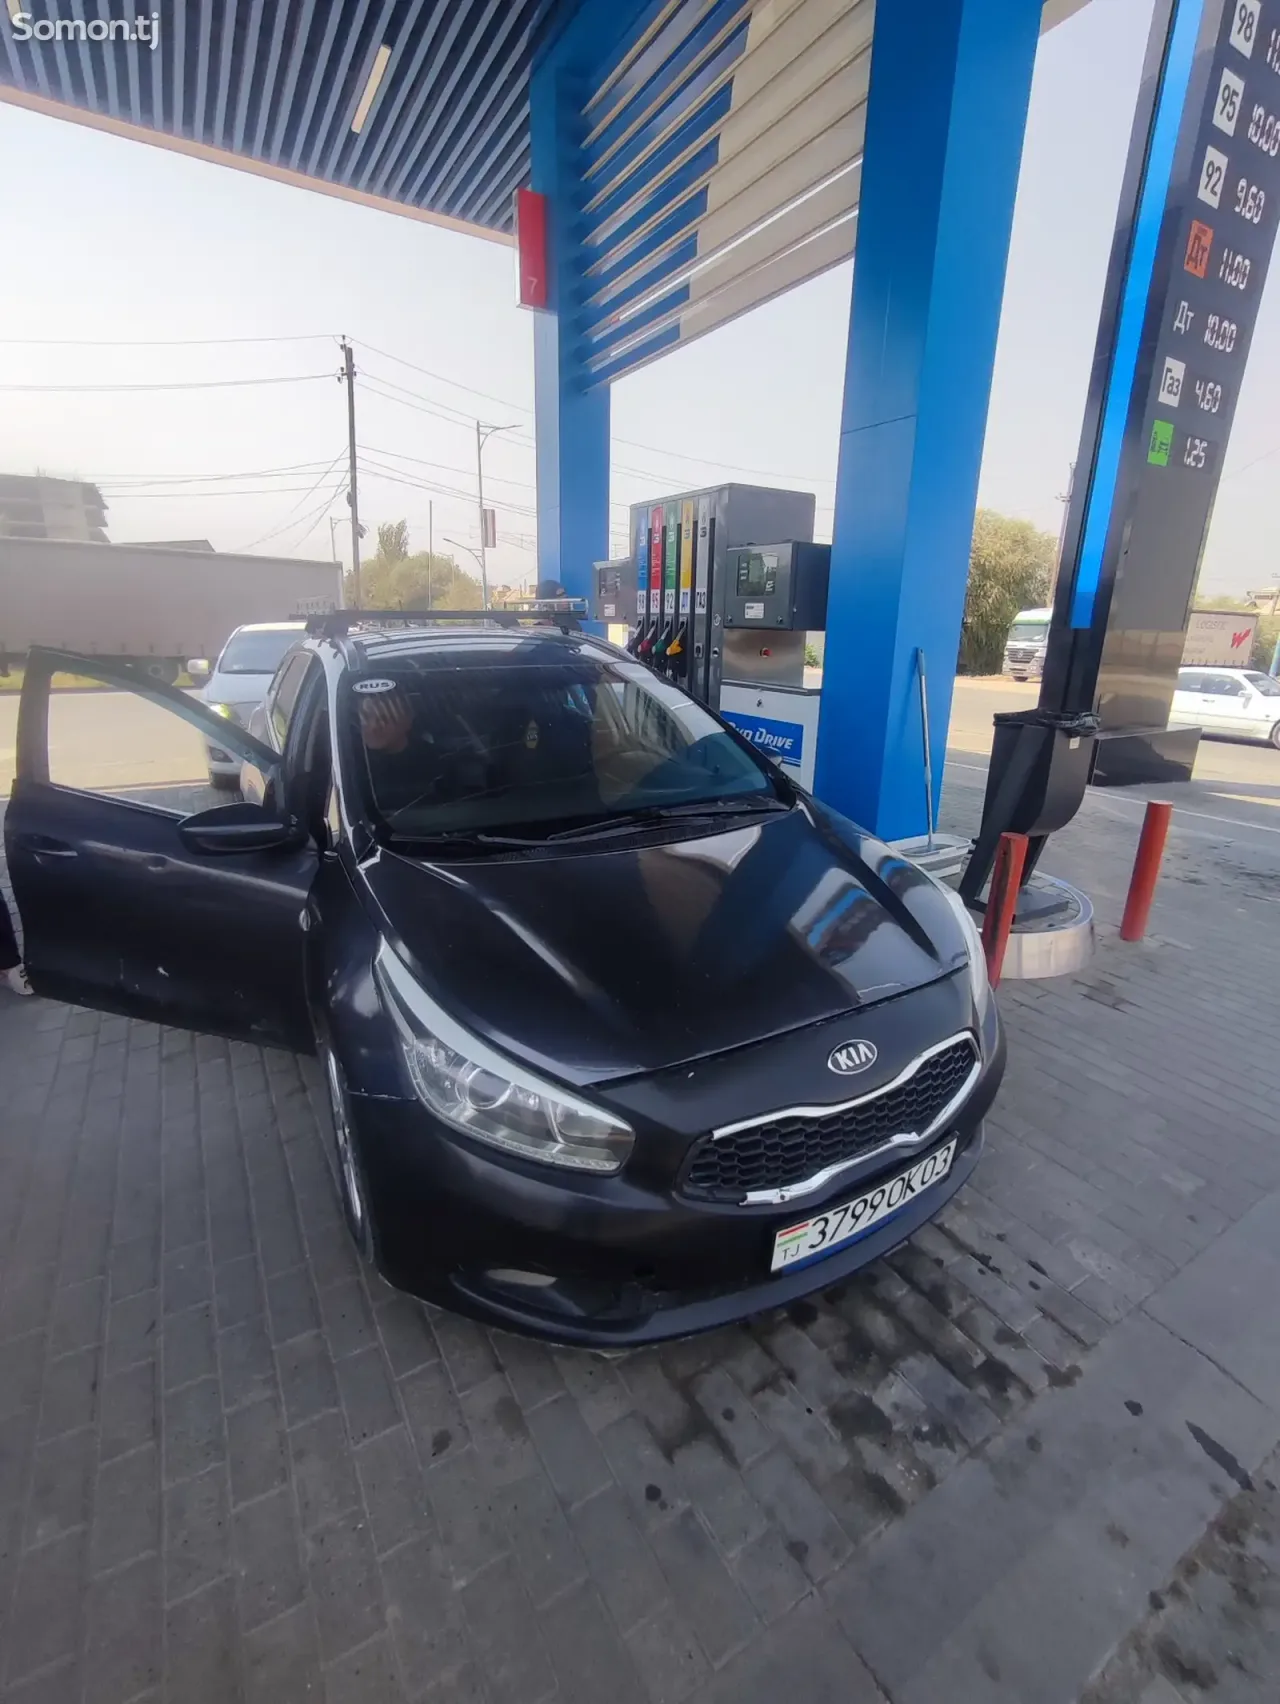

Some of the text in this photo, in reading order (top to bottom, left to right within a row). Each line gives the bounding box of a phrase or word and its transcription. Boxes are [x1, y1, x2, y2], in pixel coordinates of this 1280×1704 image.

[1237, 3, 1254, 43] 98
[1219, 84, 1239, 122] 95
[1204, 160, 1265, 224] 92 9.60
[528, 276, 538, 295] 7
[1219, 248, 1251, 290] 11.00
[1204, 313, 1237, 353] 10.00
[1162, 367, 1222, 413] Газ 4.60
[1184, 437, 1208, 468] 1.25
[359, 682, 390, 690] RUS
[754, 727, 794, 749] DRIVE
[834, 1043, 873, 1070] KIA
[782, 1244, 800, 1261] TJ
